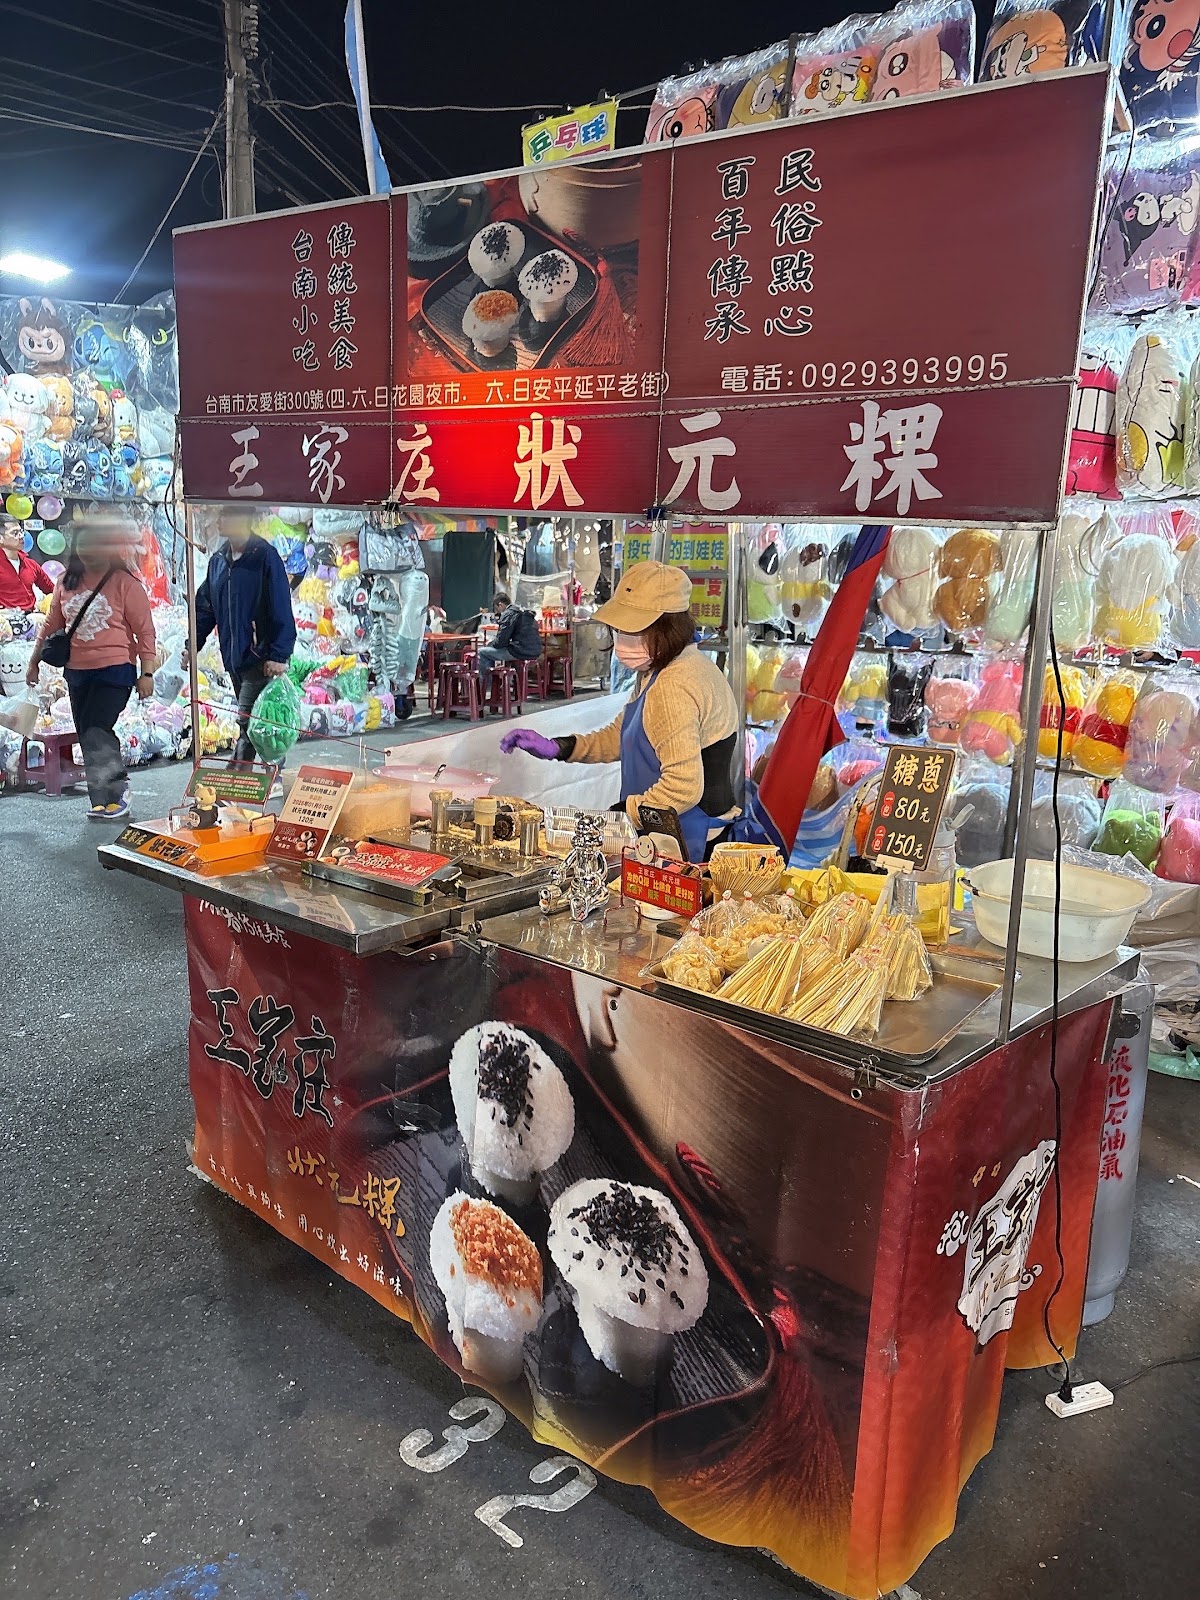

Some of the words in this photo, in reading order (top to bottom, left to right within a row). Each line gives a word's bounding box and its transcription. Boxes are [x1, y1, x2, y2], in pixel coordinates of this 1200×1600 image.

[528, 112, 607, 163] 乒乓球
[292, 228, 319, 373] 台南小吃
[327, 222, 359, 372] 傳統美食
[704, 154, 756, 344] 百年傳承
[765, 148, 823, 338] 民俗點心
[720, 353, 1009, 395] 電話:0929393995
[228, 400, 944, 516] 王家庄狀元粿
[886, 831, 924, 859] 150元
[894, 796, 931, 823] 80元
[205, 987, 337, 1128] 王家庄
[1099, 1044, 1133, 1182] 液化石油氣
[287, 1146, 406, 1237] 狀元粿
